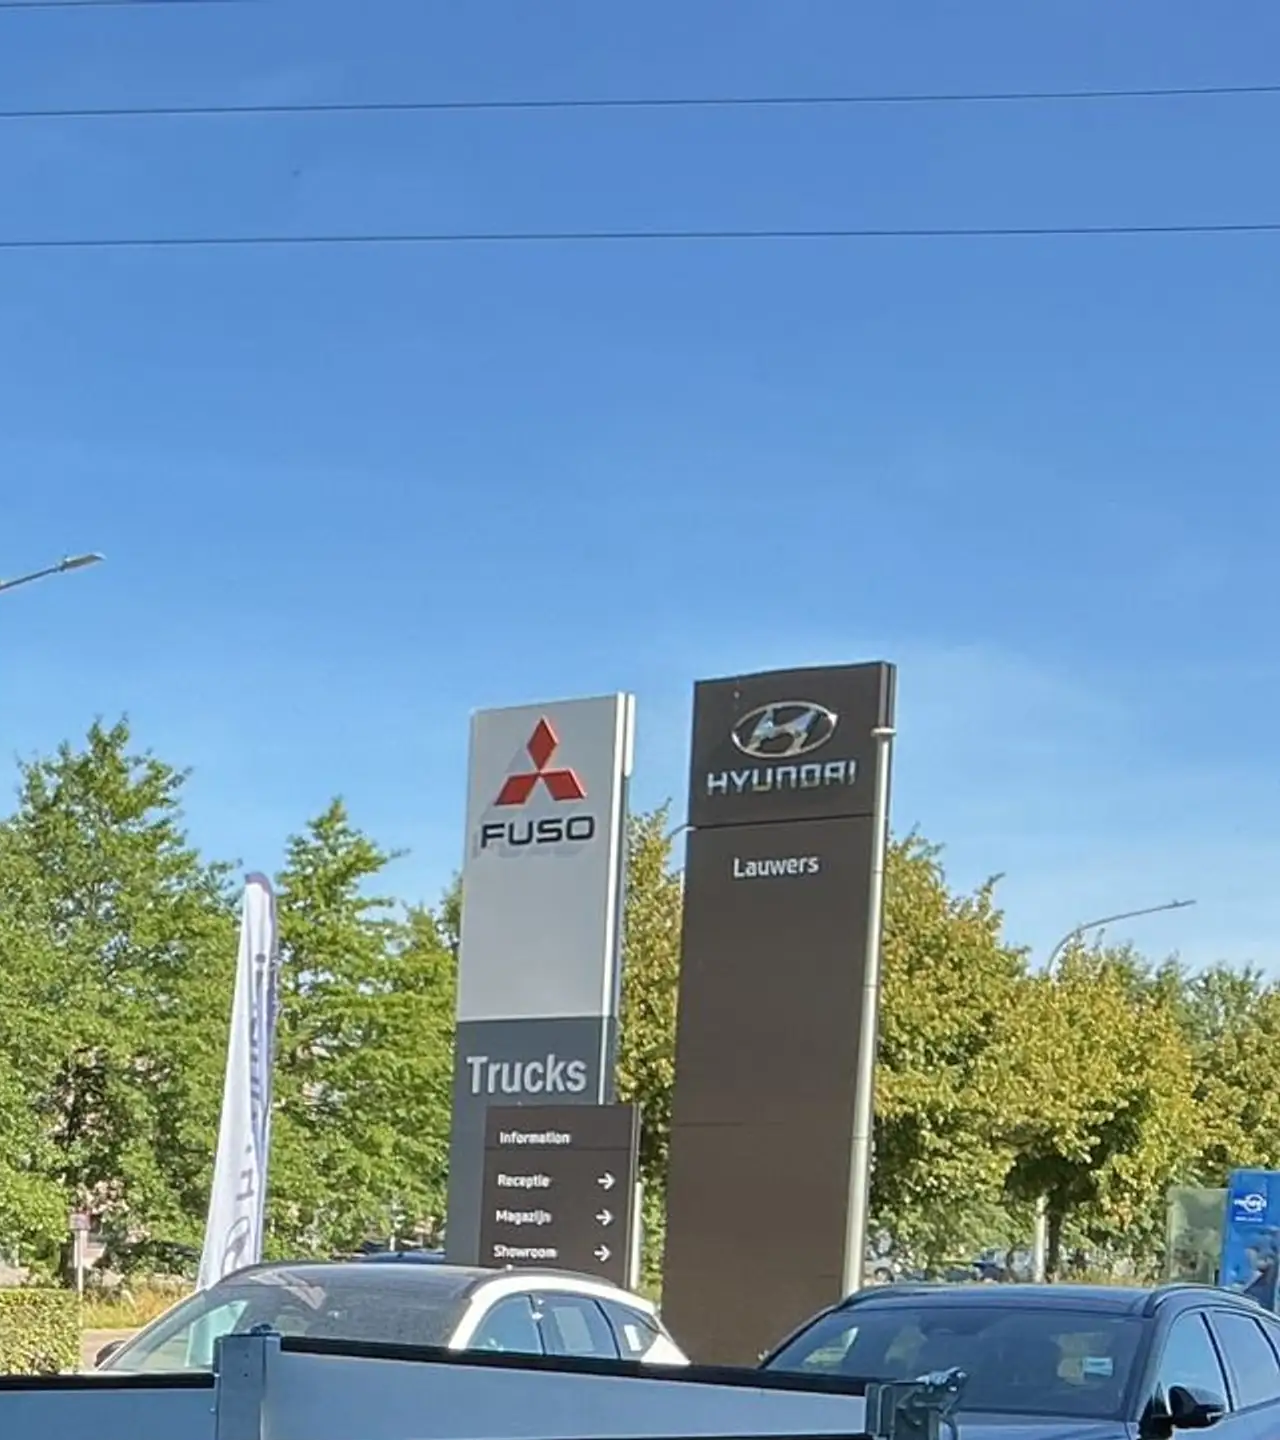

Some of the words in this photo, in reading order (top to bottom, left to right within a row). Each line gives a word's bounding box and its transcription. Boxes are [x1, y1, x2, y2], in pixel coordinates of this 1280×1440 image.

[706, 760, 857, 796] HYUNDAI
[480, 815, 596, 850] FUSO
[733, 854, 820, 879] Lauwers
[467, 1054, 588, 1094] Trucks
[499, 1131, 572, 1145] Information
[497, 1174, 552, 1189] Receptie
[495, 1210, 553, 1226] Magazijn
[493, 1244, 558, 1259] Showroom
